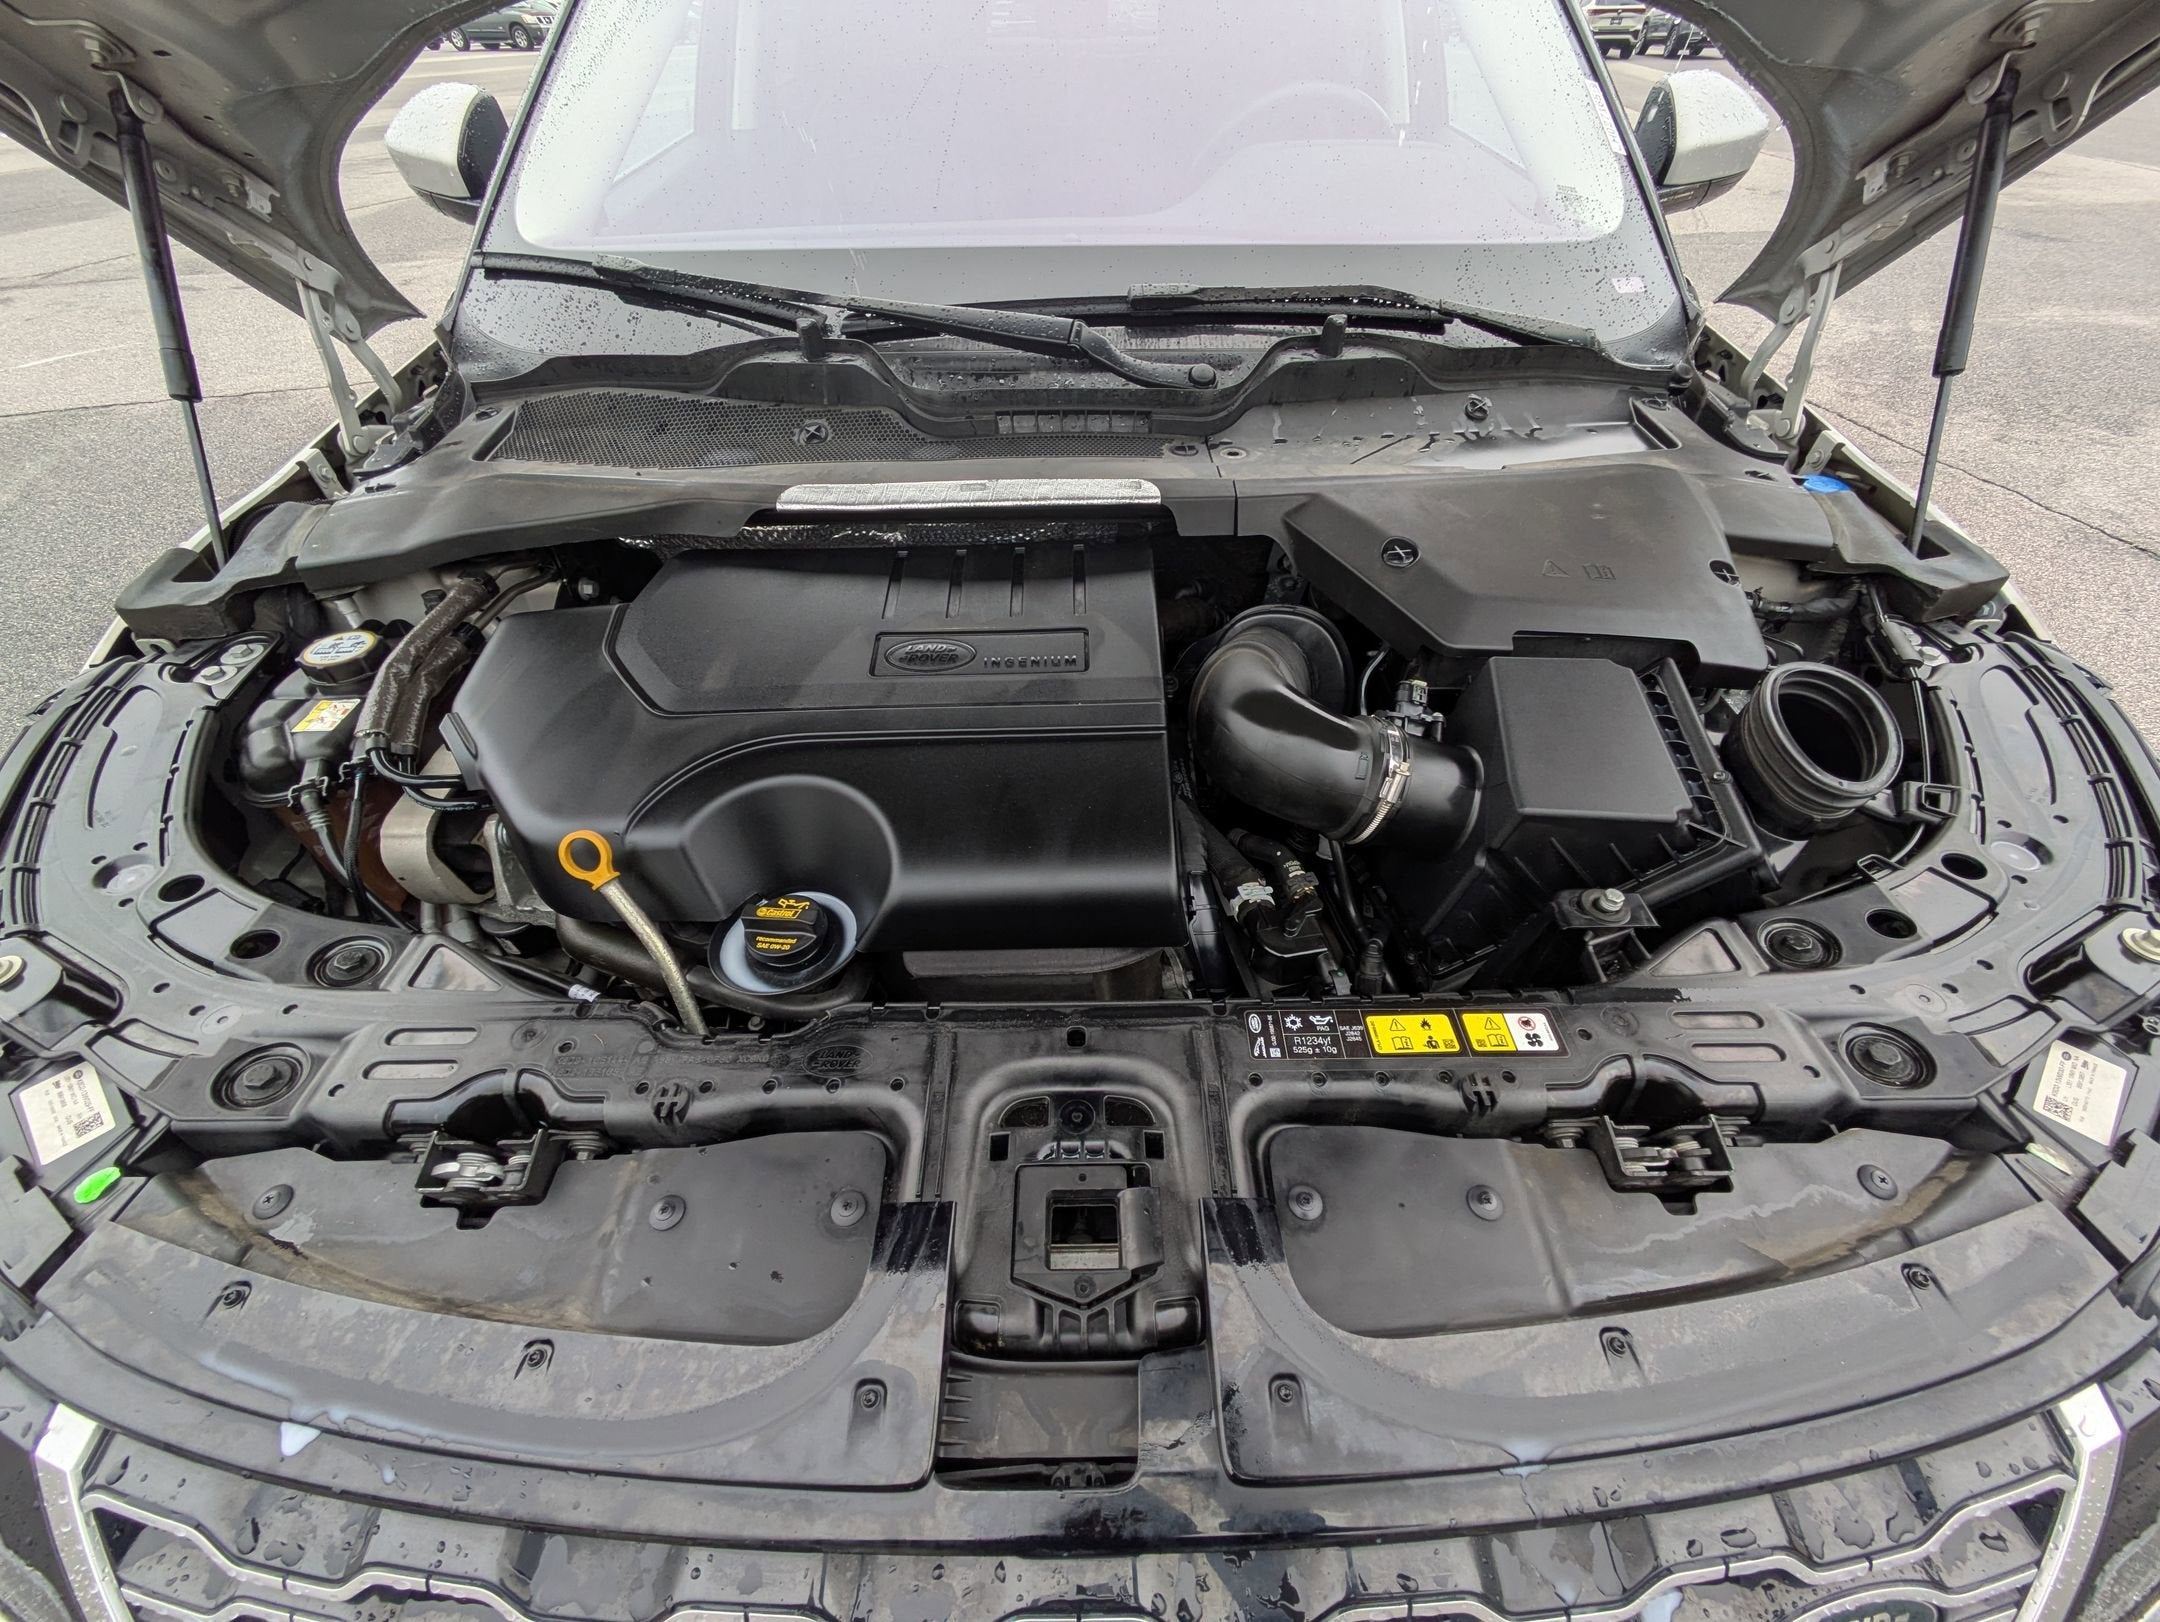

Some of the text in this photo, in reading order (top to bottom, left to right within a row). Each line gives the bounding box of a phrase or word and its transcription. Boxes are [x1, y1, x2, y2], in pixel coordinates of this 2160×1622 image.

[905, 643, 948, 653] LAND
[906, 653, 959, 664] ROVER
[983, 655, 1078, 669] INGENIUM
[766, 909, 794, 917] Castrol
[755, 936, 797, 944] recommended
[1294, 1036, 1332, 1046] R1234yf
[819, 1050, 855, 1059] LAND
[1292, 1046, 1313, 1055] 525g
[1322, 1046, 1338, 1054] 10g
[819, 1059, 862, 1068] ROVER
